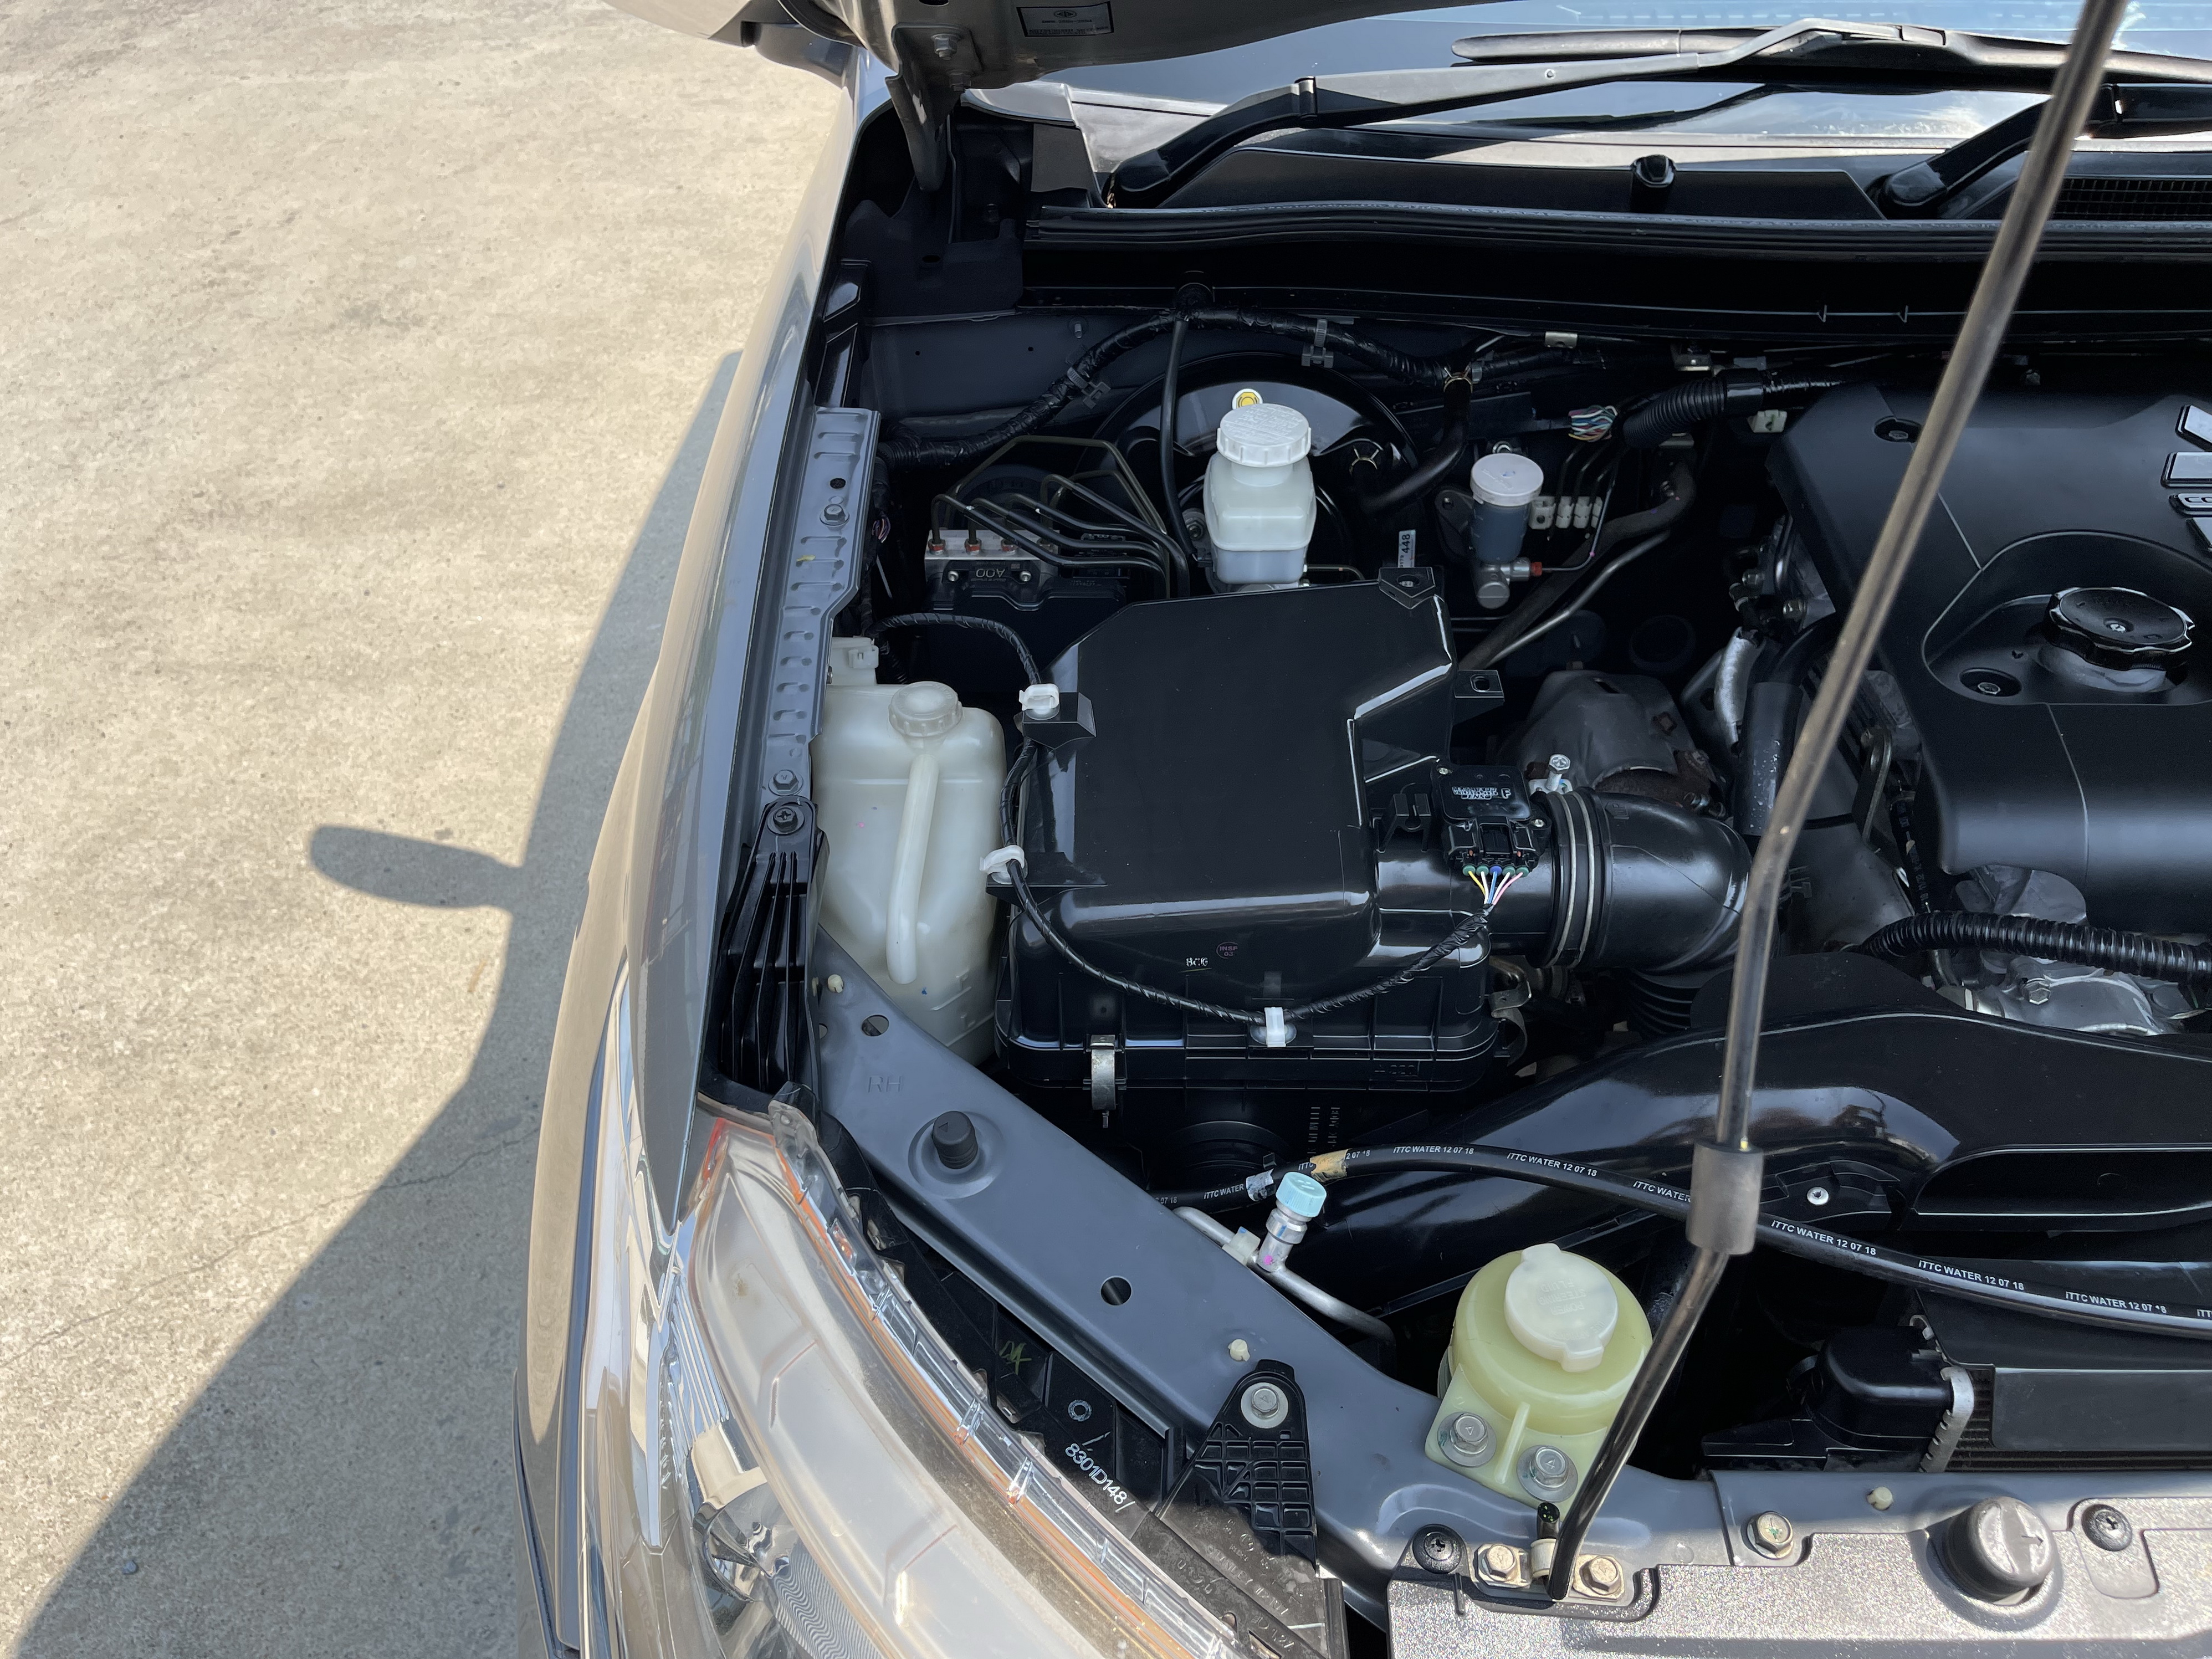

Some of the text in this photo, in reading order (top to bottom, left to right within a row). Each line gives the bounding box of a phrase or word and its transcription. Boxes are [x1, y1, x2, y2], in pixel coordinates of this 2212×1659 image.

[1401, 534, 1411, 554] 448
[868, 1075, 902, 1093] RH
[1528, 1156, 1560, 1169] WATER
[1563, 1163, 1573, 1171] 12
[1574, 1165, 1585, 1174] 07
[1587, 1168, 1597, 1177] 18
[1220, 1184, 1245, 1195] WATER
[1657, 1186, 1691, 1203] WATER
[1170, 1196, 1178, 1204] 18
[1796, 1226, 1834, 1245] WATER
[1836, 1239, 1848, 1248] 12
[1850, 1242, 1862, 1252] 07
[1865, 1246, 1876, 1256] 18
[1540, 1278, 1575, 1292] FLUID
[1944, 1266, 1982, 1283] WATER
[1985, 1275, 1996, 1284] 12
[1998, 1278, 2010, 1287] 07
[2013, 1281, 2024, 1291] 18
[1538, 1288, 1588, 1306] STEERING
[2089, 1295, 2127, 1309] WATER
[2128, 1302, 2141, 1311] 12
[2141, 1303, 2153, 1313] 07
[1550, 1300, 1586, 1315] POWER
[1065, 1443, 1128, 1505] 8301D148
[1206, 1545, 1254, 1586] STANLEY
